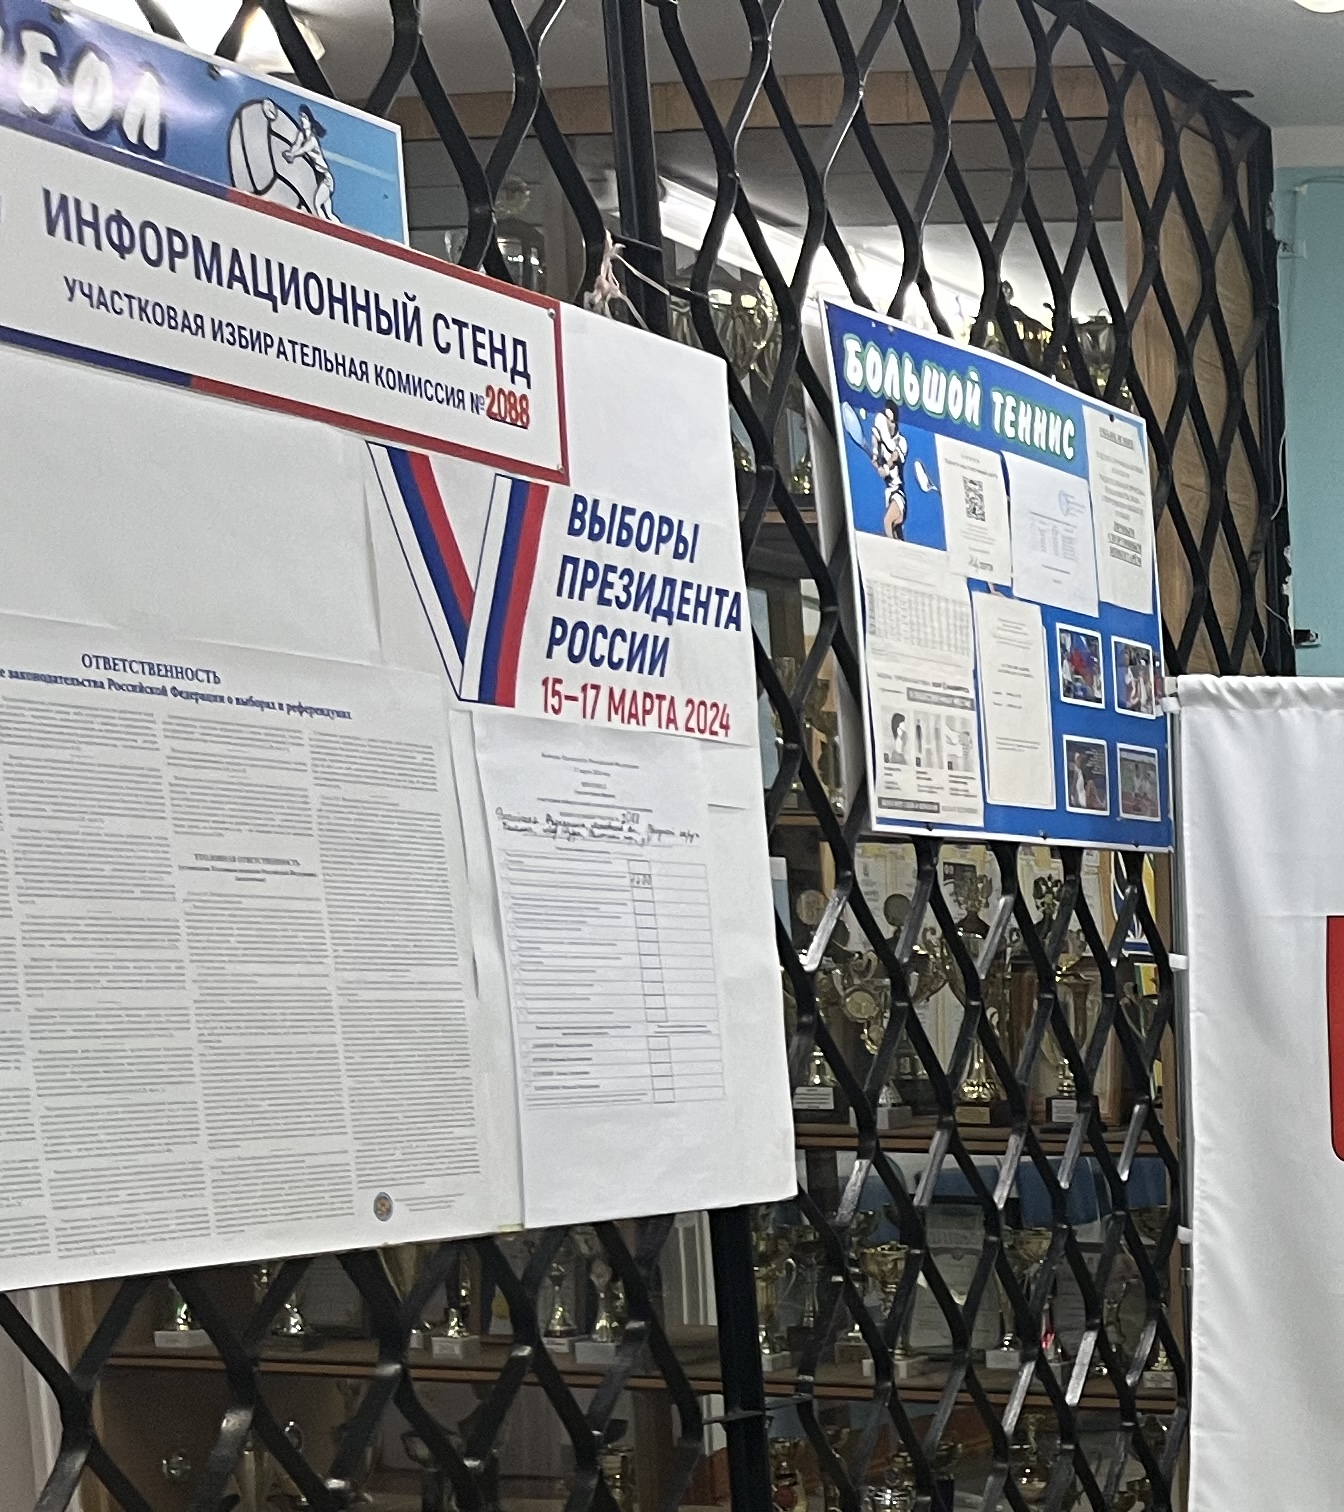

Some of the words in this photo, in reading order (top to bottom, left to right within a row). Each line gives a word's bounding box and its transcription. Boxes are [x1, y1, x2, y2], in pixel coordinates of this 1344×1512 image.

[0, 28, 163, 152] БОЛ
[42, 187, 423, 347] ИНФОРМАЦИОННЫЙ
[433, 312, 532, 389] СТЕНД
[63, 275, 206, 338] УЧАСТКОВАЯ
[212, 321, 370, 383] ИЗБИРАТЕЛЬНАЯ
[374, 363, 466, 411] КОМИССИЯ
[844, 337, 983, 427] БОЛЬШОЙ
[992, 391, 1075, 460] ТЕННИС
[567, 493, 700, 564] ВЫБОРЫ
[556, 554, 743, 632] ПРЕЗИДЕНТА
[81, 653, 221, 686] ОТВЕТСТВЕННОСТЬ
[546, 616, 670, 678] РОССИИ
[607, 685, 678, 731] МАРТА
[684, 699, 731, 738] 2024
